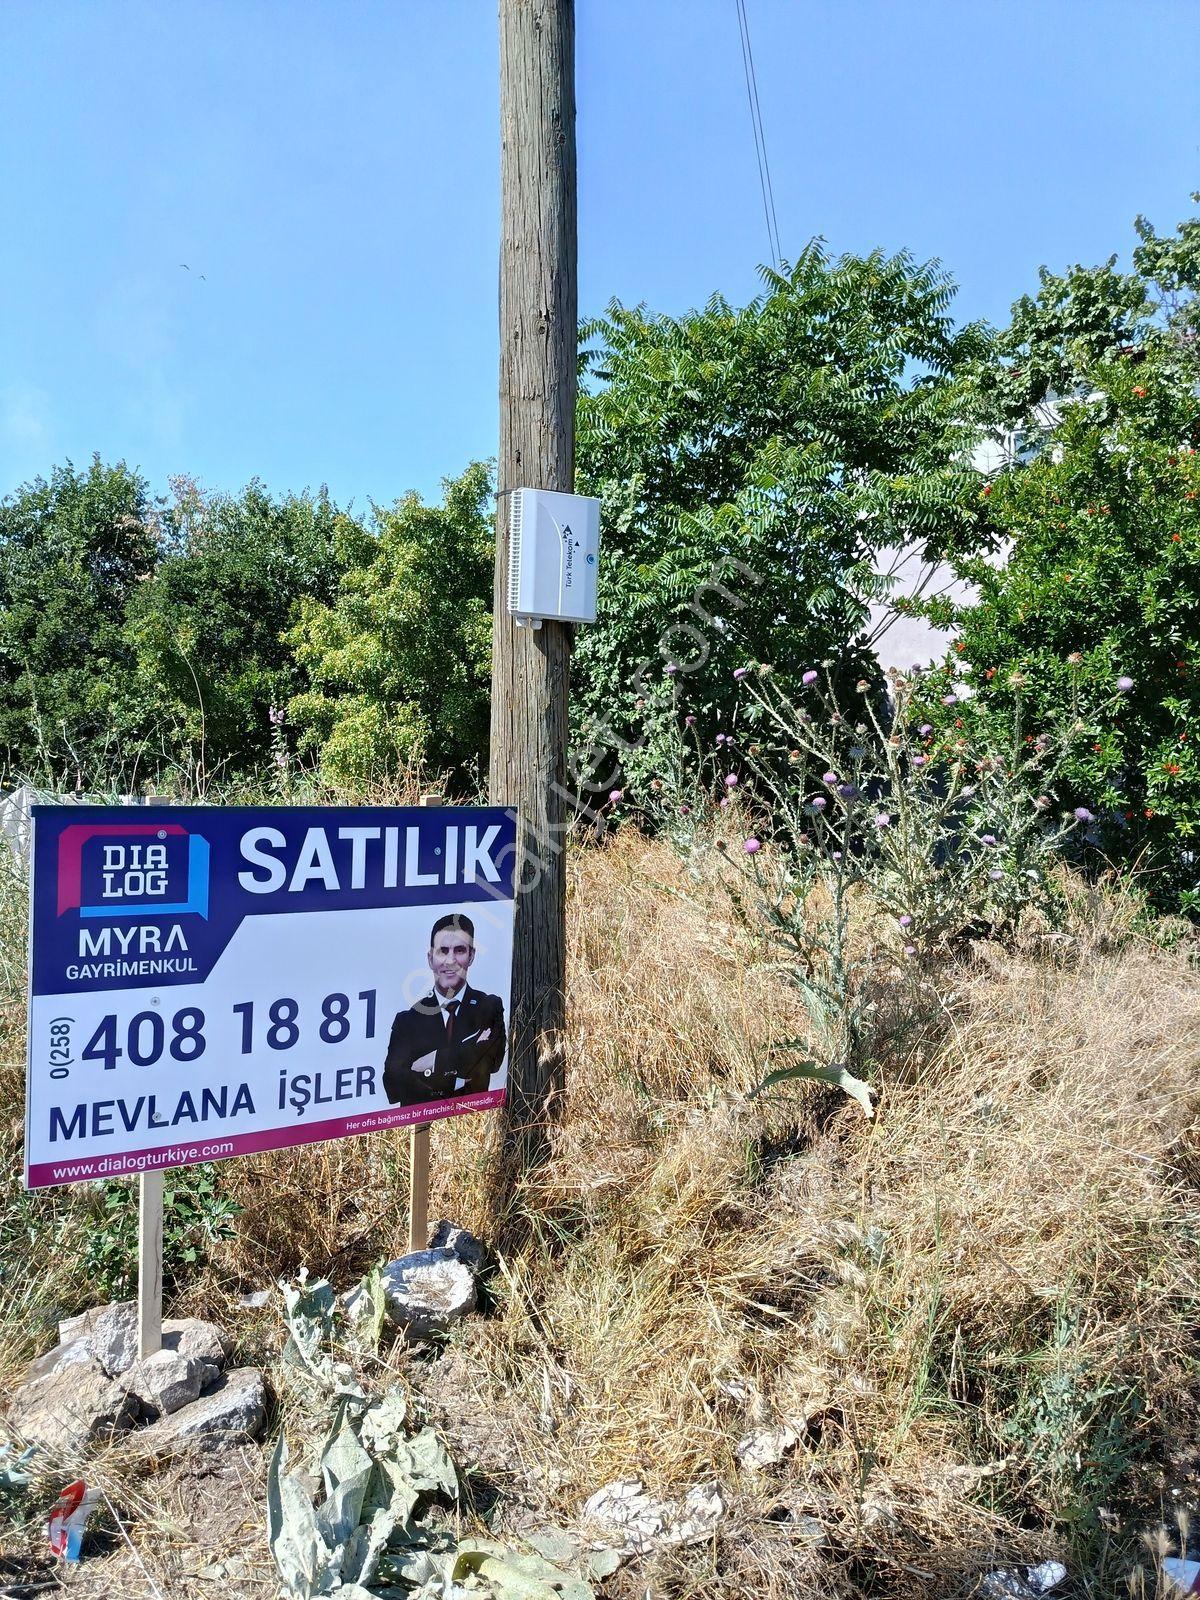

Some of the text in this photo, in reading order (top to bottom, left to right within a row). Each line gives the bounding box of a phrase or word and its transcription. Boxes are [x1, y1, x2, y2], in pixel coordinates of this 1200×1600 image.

[102, 844, 169, 870] DIA
[238, 825, 502, 894] SATILIK
[102, 870, 169, 898] LOG
[66, 957, 198, 980] GAYRİMENKUL
[49, 1016, 75, 1079] 0(258)
[81, 988, 377, 1070] 408 18 81
[49, 1065, 376, 1143] MEVLANA İŞLER
[346, 1122, 360, 1131] Her
[361, 1117, 376, 1128] ofis
[377, 1110, 411, 1126] bağımsız
[412, 1109, 421, 1118] bir
[53, 1140, 234, 1179] www.dialogturkiye.com
